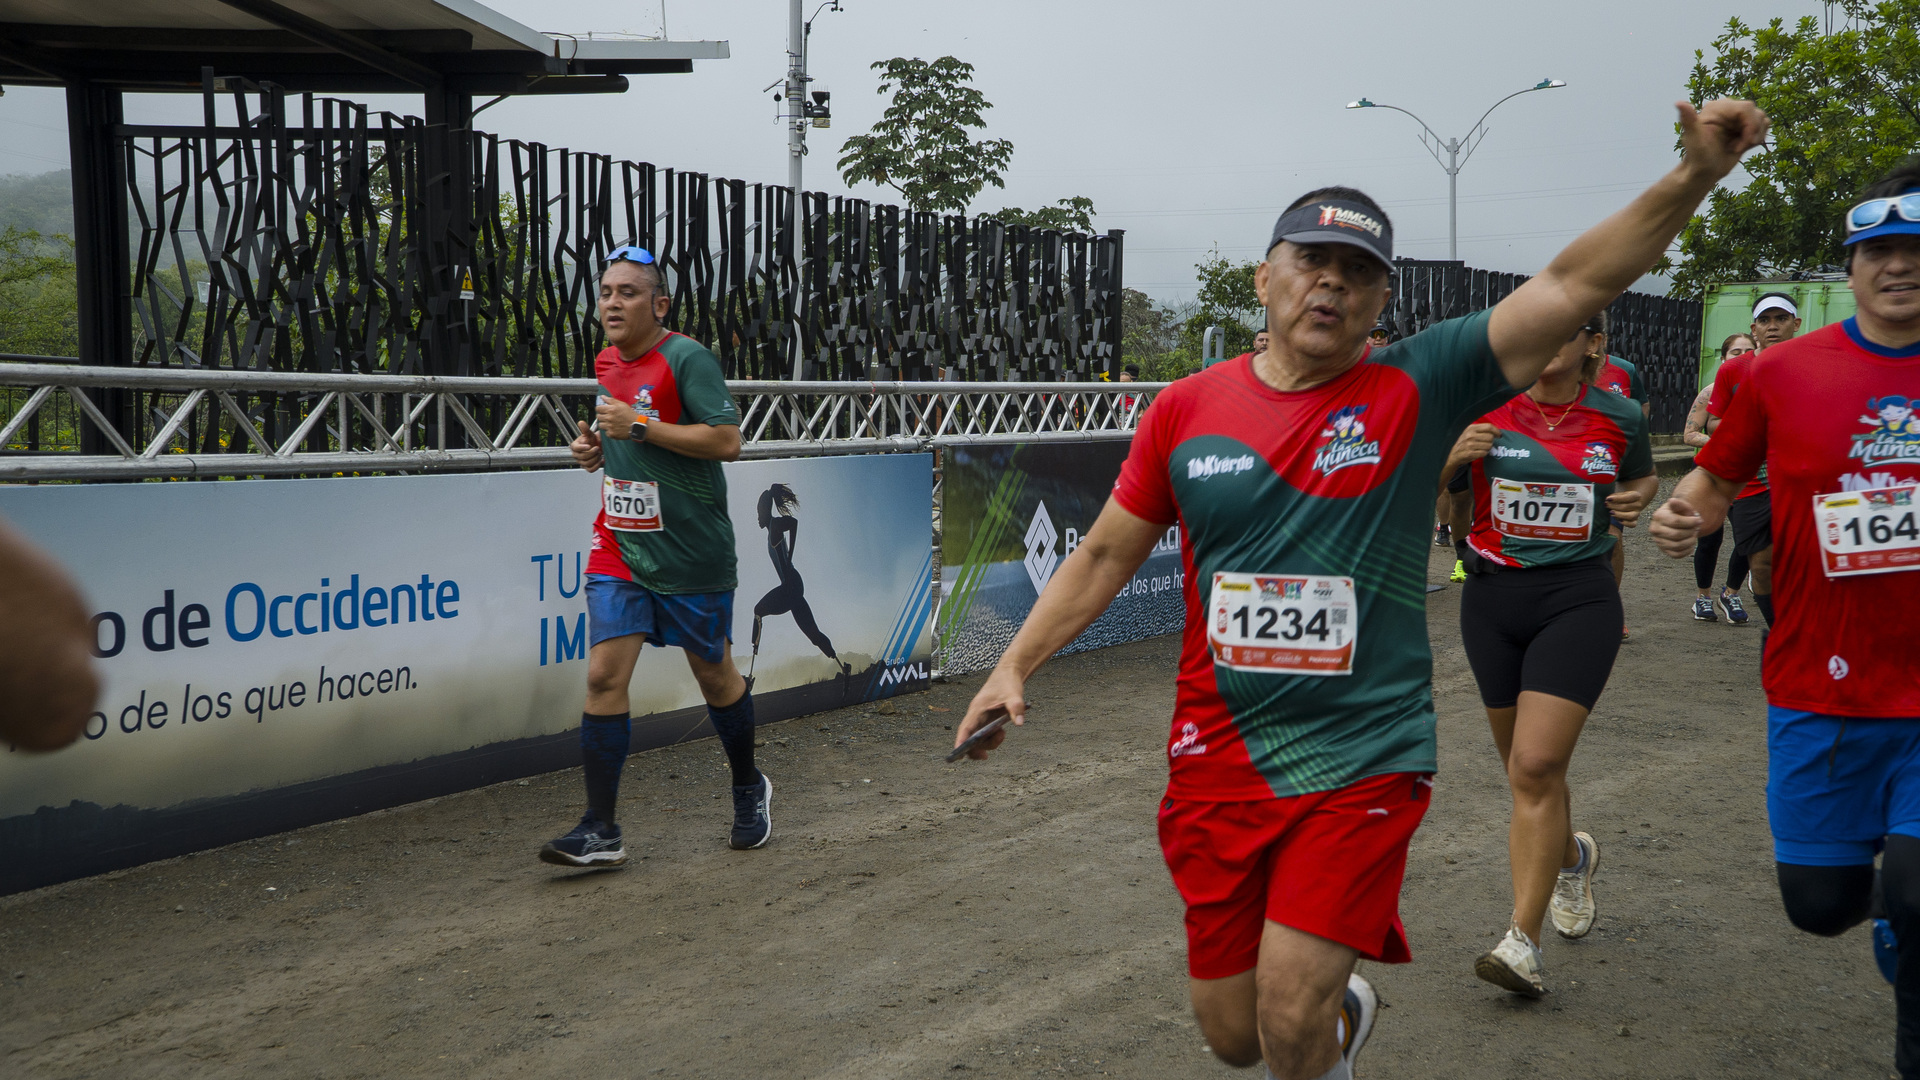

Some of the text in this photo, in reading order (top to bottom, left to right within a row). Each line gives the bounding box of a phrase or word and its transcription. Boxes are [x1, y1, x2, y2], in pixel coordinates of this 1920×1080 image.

[607, 494, 646, 516] 1670
[1508, 500, 1575, 523] 1077
[1844, 511, 1919, 546] 164
[531, 551, 581, 601] TU
[1132, 573, 1149, 596] los
[1151, 574, 1172, 598] que
[142, 589, 210, 652] de
[225, 574, 460, 642] Occidente
[1232, 605, 1330, 642] 1234
[879, 662, 928, 687] AVAL
[885, 656, 905, 667] Grupo
[119, 690, 169, 733] de
[181, 683, 233, 724] los
[244, 681, 307, 724] que
[317, 665, 418, 704] hacen.
